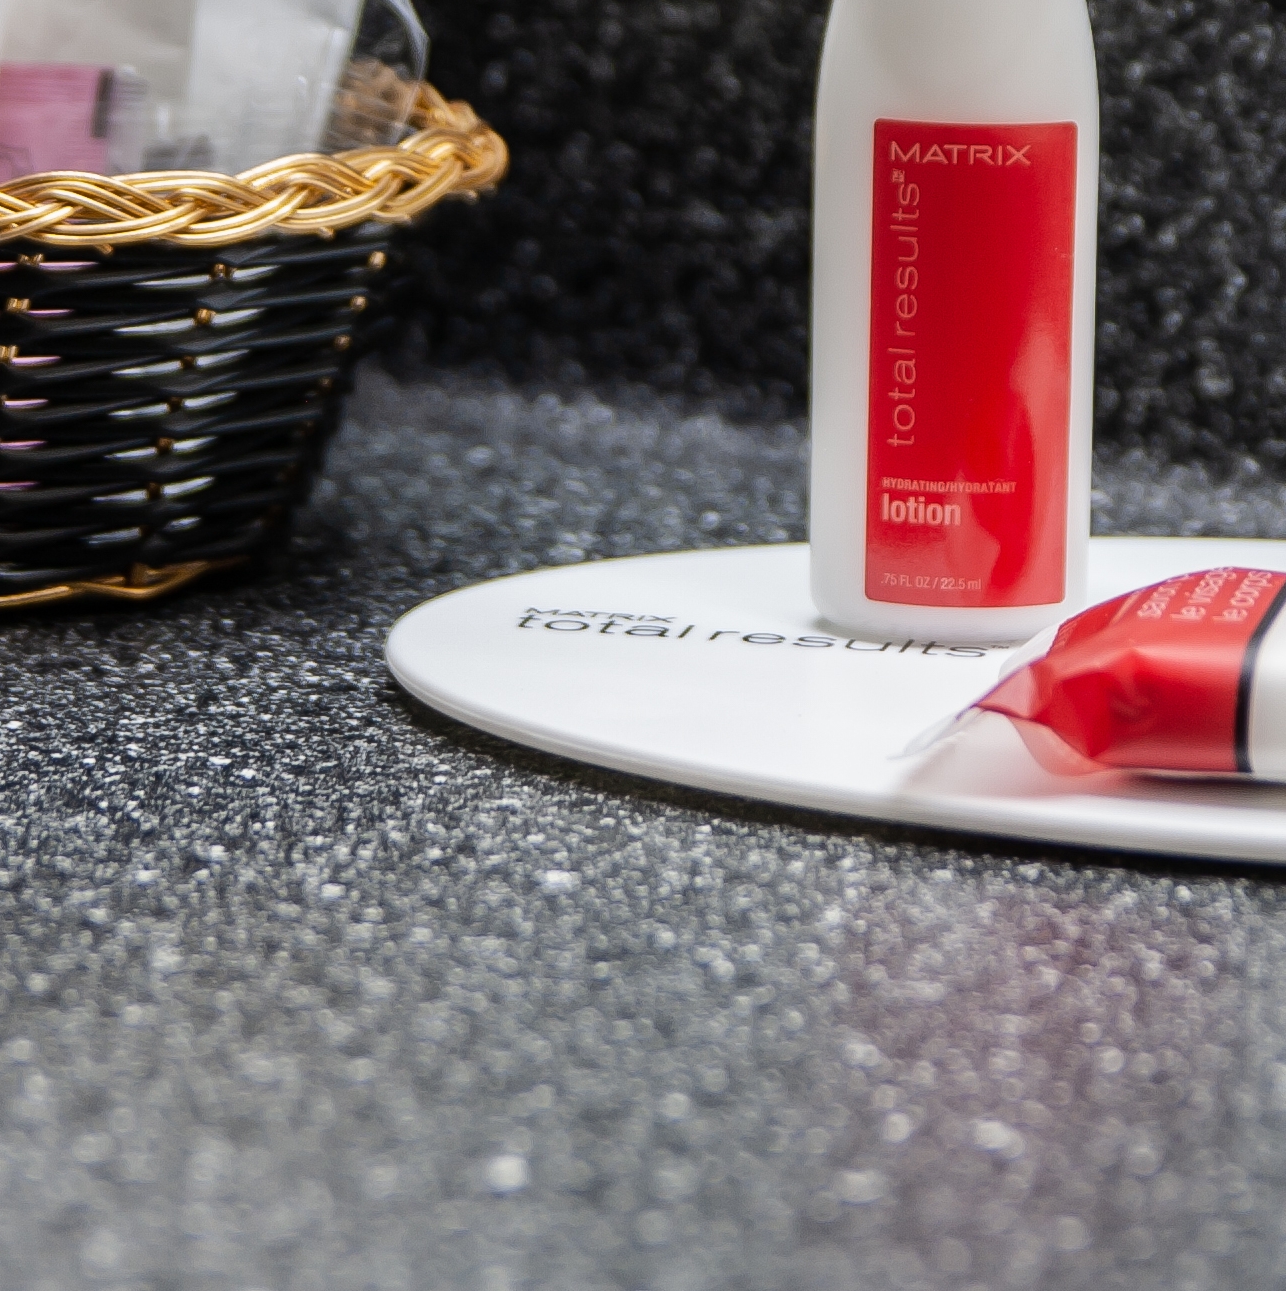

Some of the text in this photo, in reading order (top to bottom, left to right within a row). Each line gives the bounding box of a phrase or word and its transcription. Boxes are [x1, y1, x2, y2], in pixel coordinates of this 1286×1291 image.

[890, 140, 1031, 166] MATRIX
[887, 346, 916, 448] total
[882, 493, 961, 526] lotion
[881, 572, 897, 586] .75
[916, 575, 931, 588] OZ
[968, 578, 982, 590] ml
[517, 614, 696, 640] total
[525, 607, 677, 624] MATRIX
